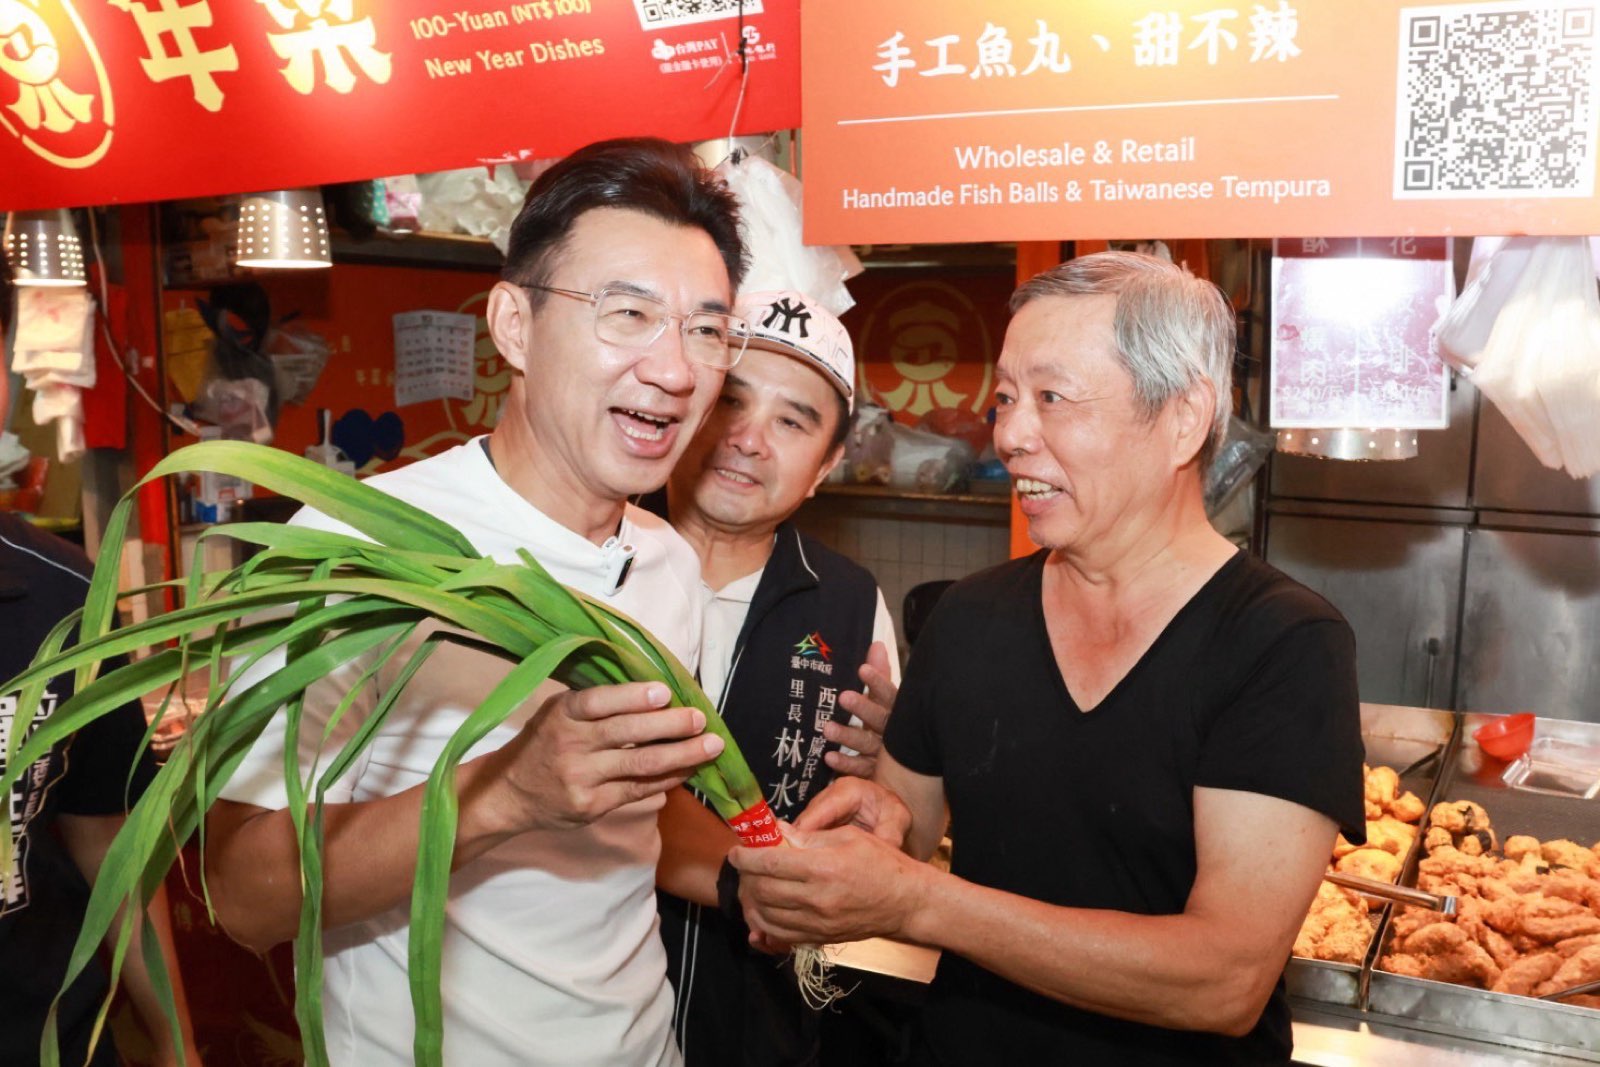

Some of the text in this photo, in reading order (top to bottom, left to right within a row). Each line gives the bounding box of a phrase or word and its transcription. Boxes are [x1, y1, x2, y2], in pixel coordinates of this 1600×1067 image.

[410, 11, 509, 40] 100-Yuan
[872, 0, 1303, 88] 手工魚丸、甜不辣
[424, 37, 606, 79] New Year Dishes
[954, 136, 1196, 170] Wholesale & Retail
[842, 175, 1332, 209] Handmade Fish Balls & Taiwanese Tempura
[766, 727, 805, 819] 林水
